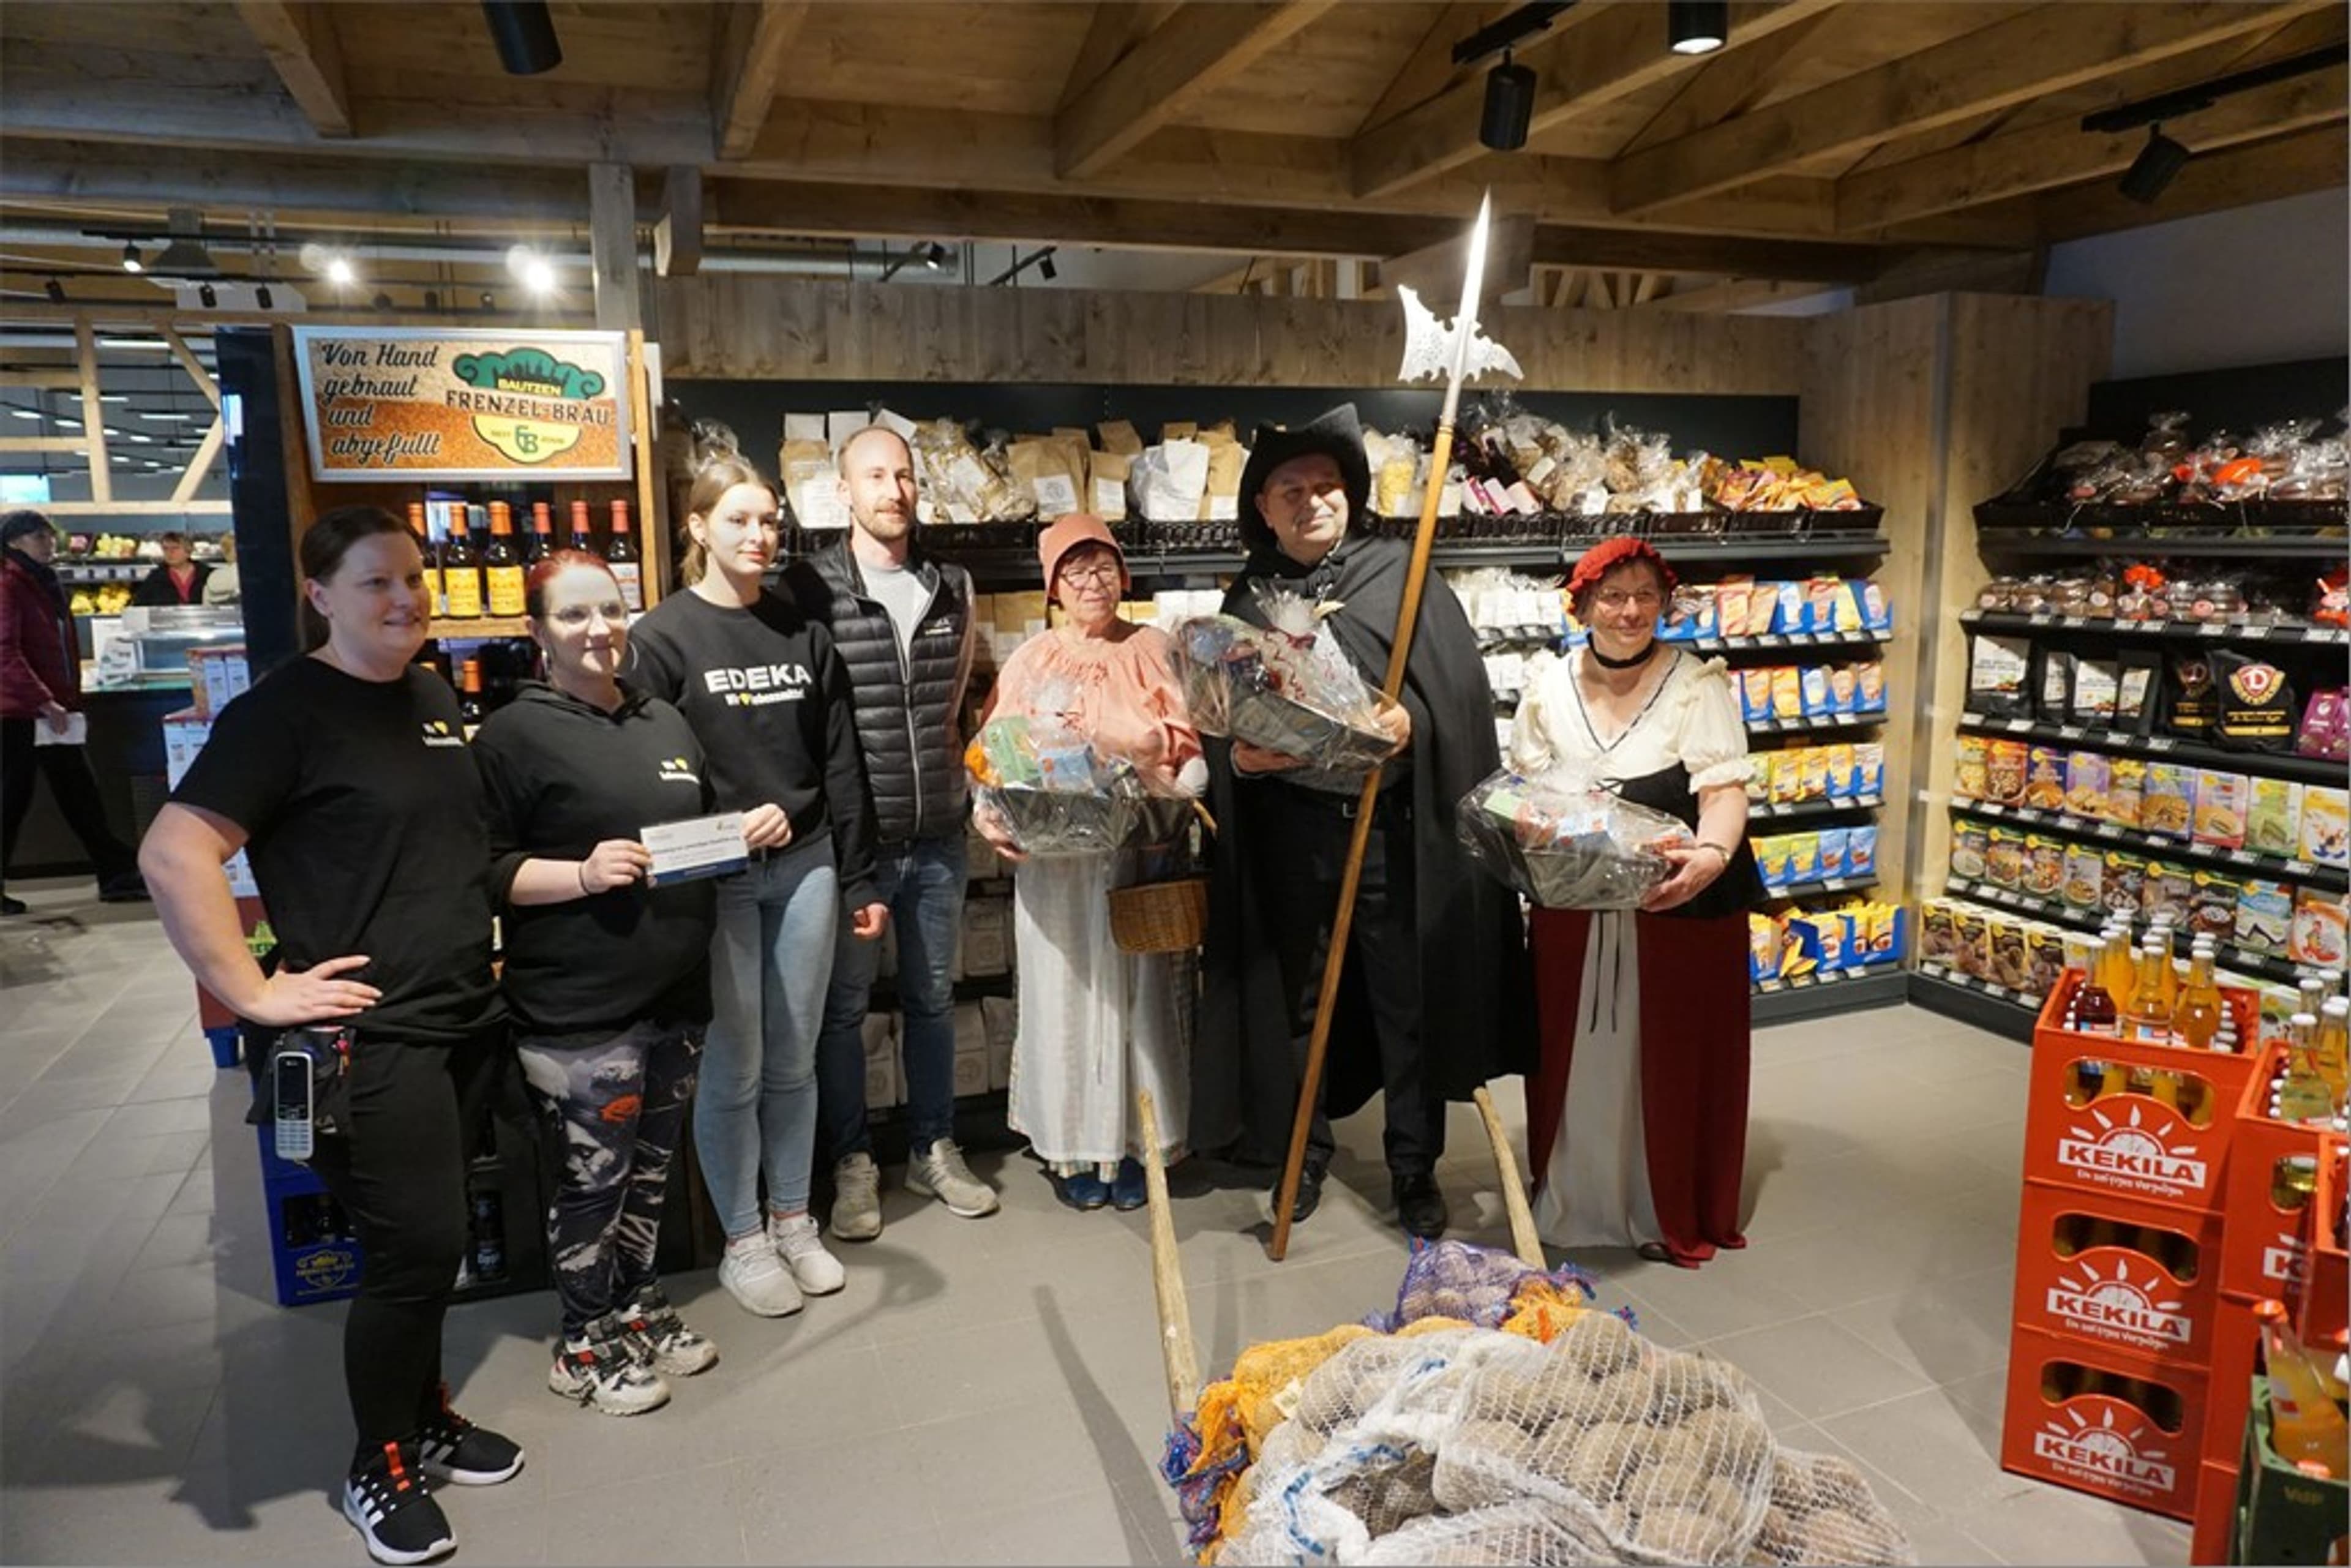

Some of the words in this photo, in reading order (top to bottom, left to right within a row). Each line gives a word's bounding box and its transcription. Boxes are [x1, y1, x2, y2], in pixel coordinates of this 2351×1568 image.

[321, 344, 367, 366] Von
[376, 344, 439, 367] Hand
[323, 373, 418, 407] gebraut
[498, 378, 561, 396] BAUTZEN
[329, 404, 373, 426] und
[331, 431, 440, 465] abgefüllt
[705, 664, 812, 693] EDEKA
[2067, 1144, 2195, 1182] KEKILA
[2057, 1295, 2182, 1337] KEKILA
[2043, 1439, 2165, 1485] KEKILA
